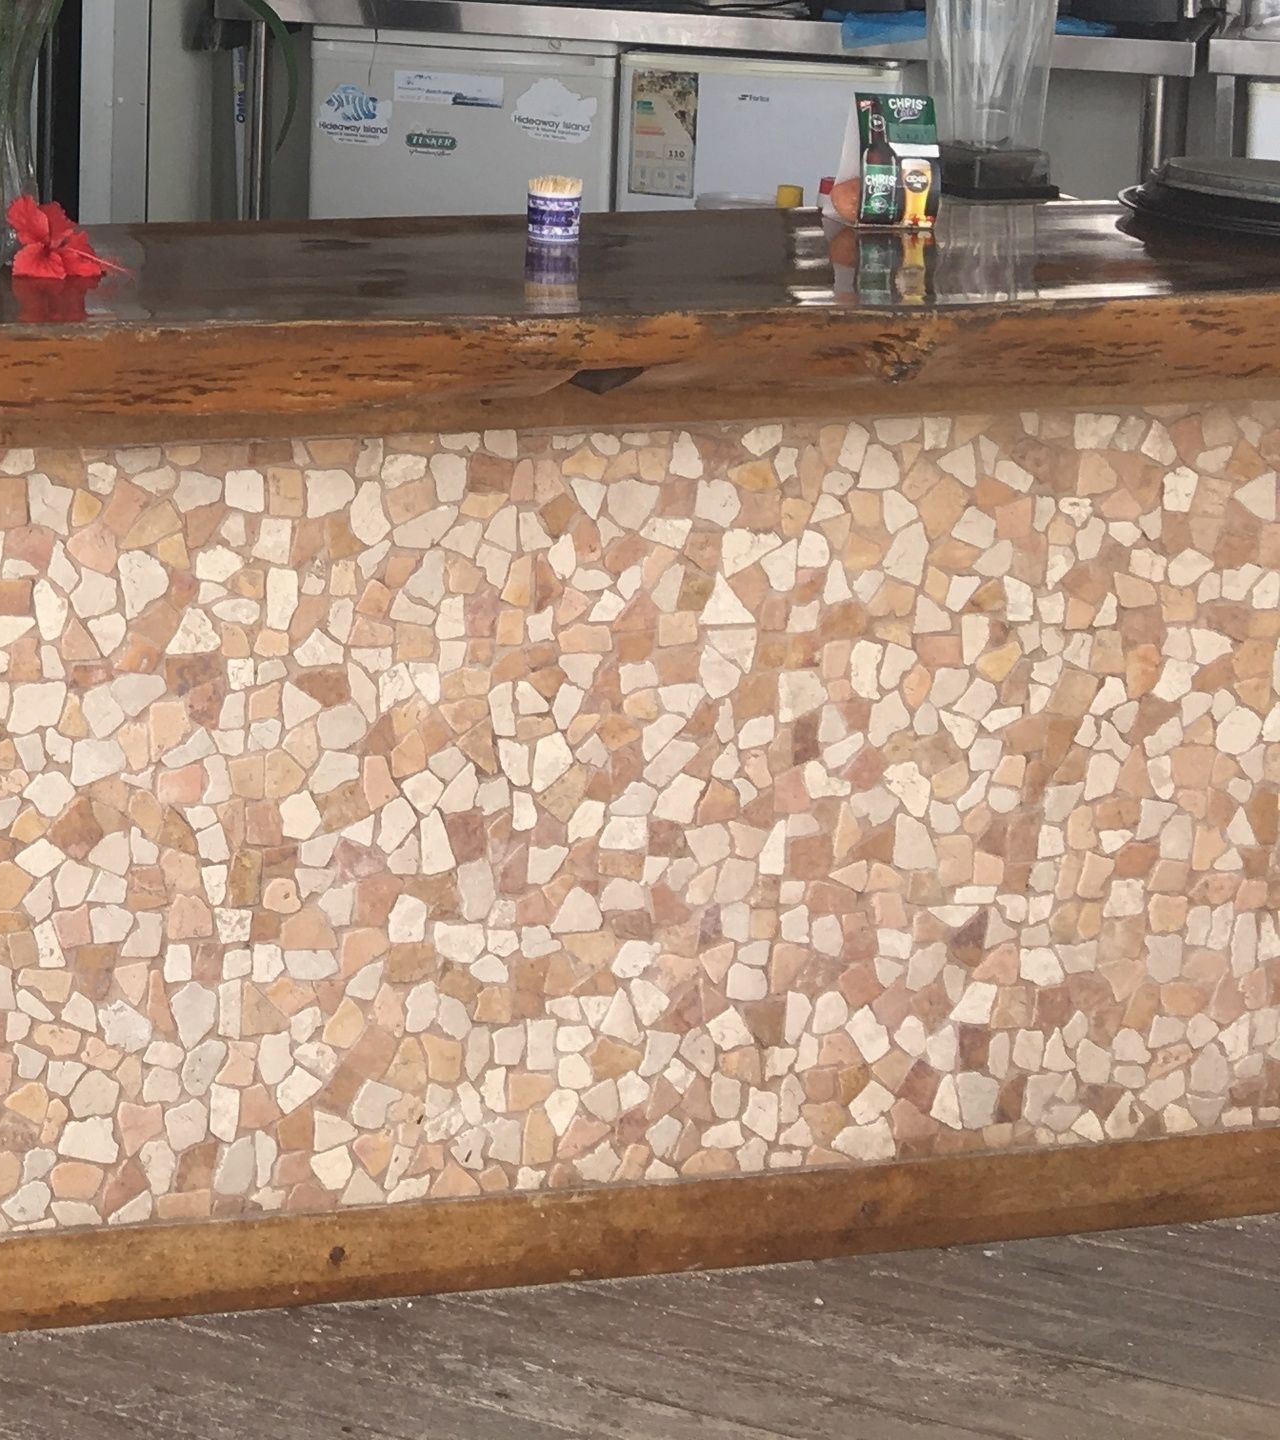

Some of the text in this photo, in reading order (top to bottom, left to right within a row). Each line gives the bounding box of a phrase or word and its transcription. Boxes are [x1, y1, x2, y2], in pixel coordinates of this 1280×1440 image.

[318, 121, 361, 134] Hideaway
[363, 124, 388, 135] Island
[513, 114, 561, 129] Hideaway
[562, 120, 591, 132] Island
